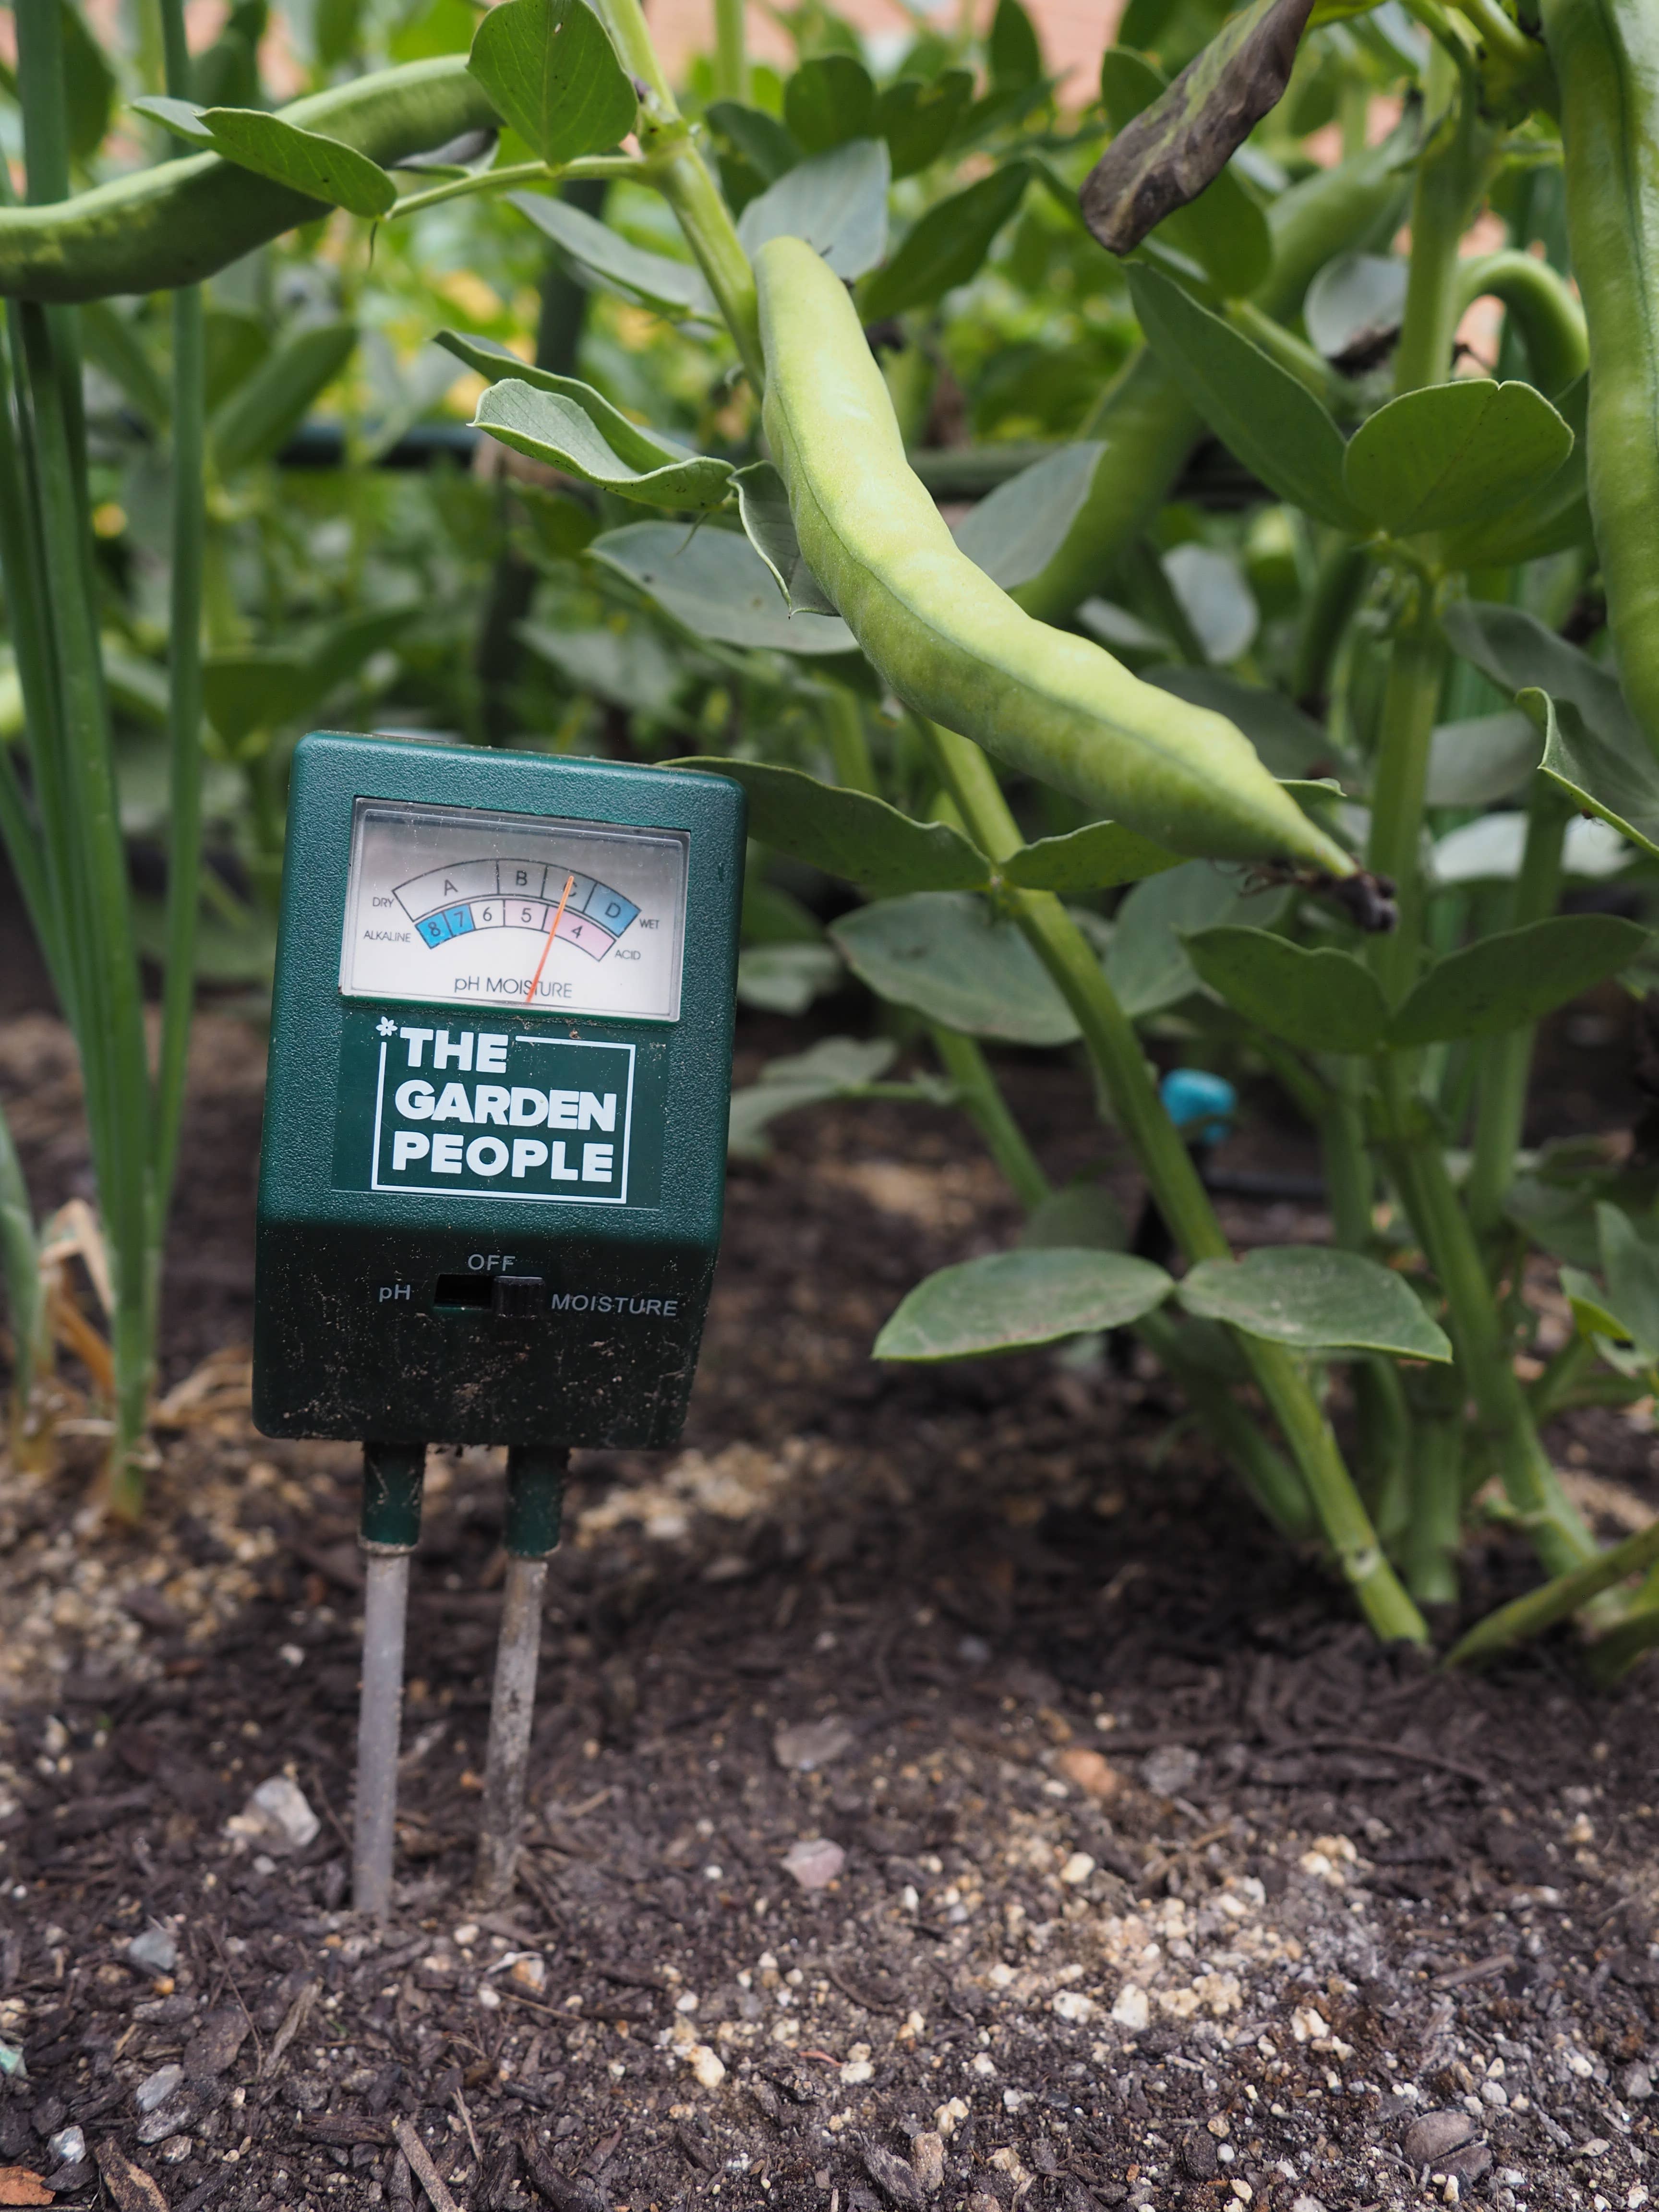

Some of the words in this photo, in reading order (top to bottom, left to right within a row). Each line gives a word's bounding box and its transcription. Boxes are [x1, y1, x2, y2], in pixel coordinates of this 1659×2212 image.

[373, 897, 395, 908] DRY
[443, 879, 458, 896] A
[516, 870, 528, 887] B
[563, 879, 577, 897] C
[605, 902, 621, 919] D
[639, 917, 660, 930] WET
[363, 930, 411, 943] ALKALINE
[429, 922, 442, 937] 8
[454, 912, 464, 927] 7
[482, 907, 493, 922] 6
[521, 908, 532, 923] 5
[571, 925, 582, 939] 4
[614, 949, 641, 961] ACID
[454, 975, 480, 993] pH
[400, 1027, 509, 1074] THE
[395, 1079, 617, 1132] GARDEN
[392, 1130, 614, 1183] PEOPLE
[468, 1253, 517, 1272] OFF
[379, 1284, 411, 1302] pH
[552, 1294, 678, 1317] MOISTURE
